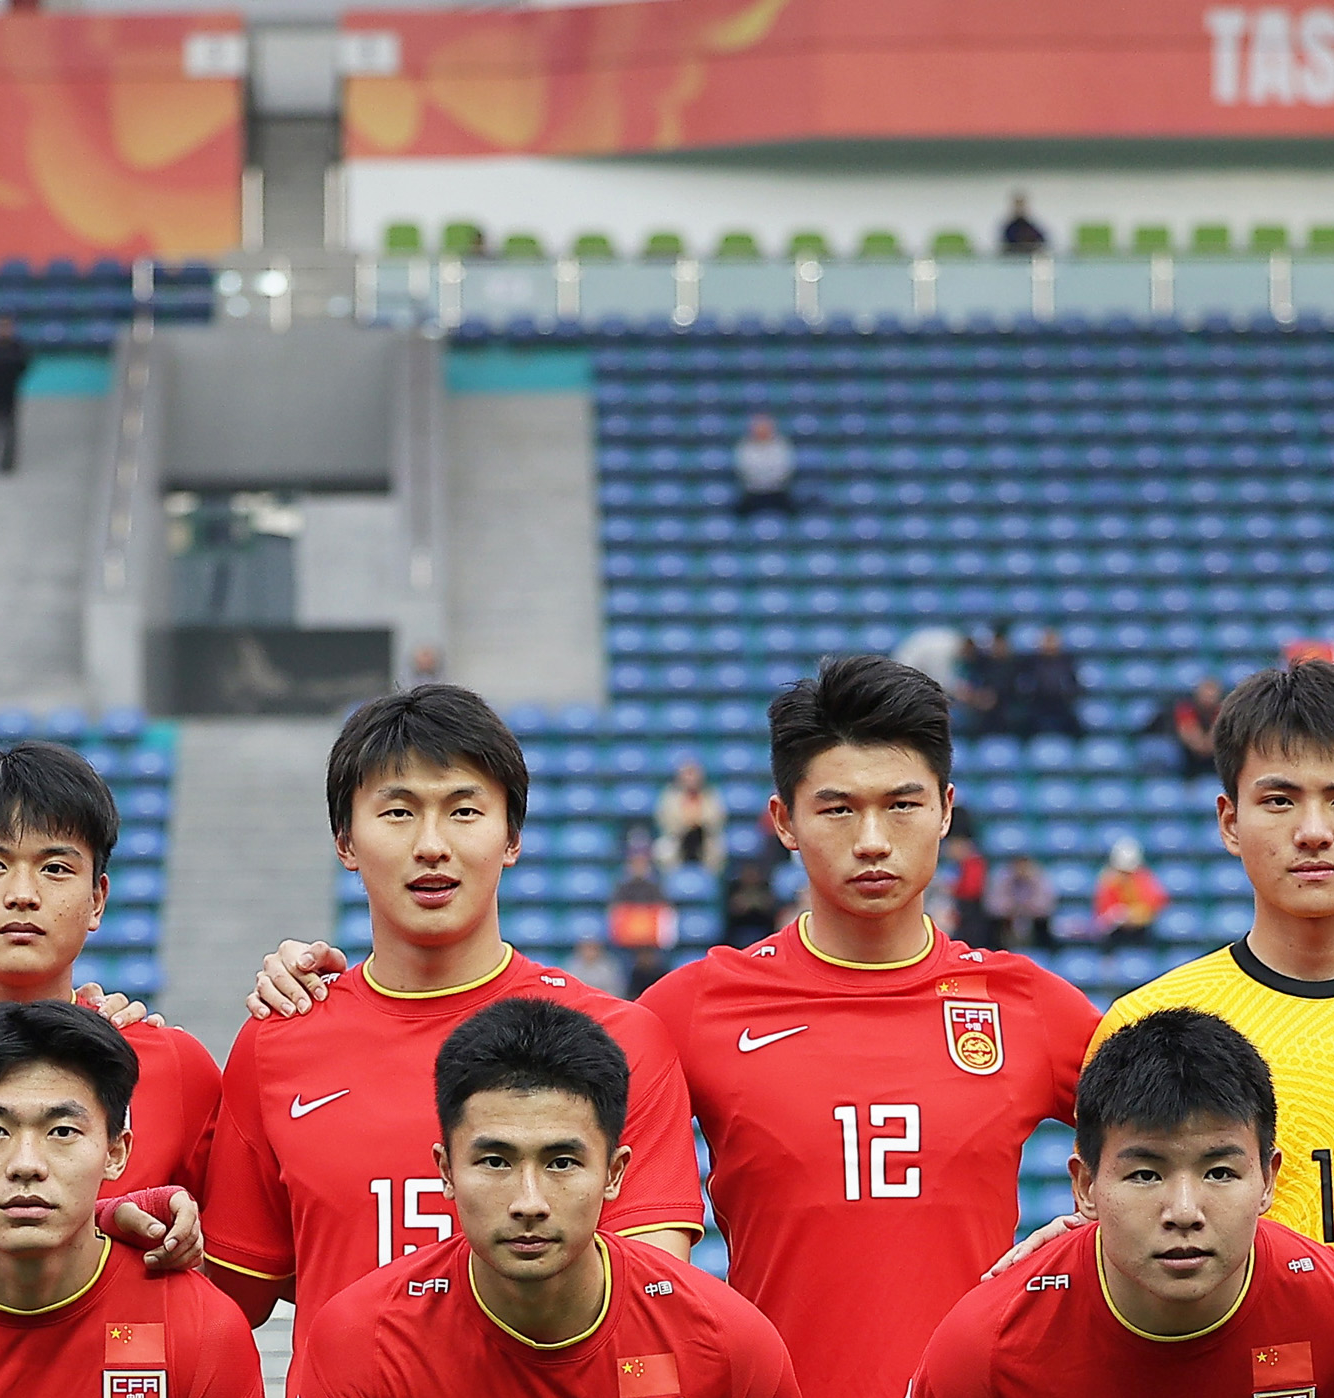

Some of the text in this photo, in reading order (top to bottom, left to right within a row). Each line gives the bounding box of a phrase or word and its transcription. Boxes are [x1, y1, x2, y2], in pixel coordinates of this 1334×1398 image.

[320, 972, 341, 985] FA
[951, 1008, 993, 1023] CFA
[832, 1102, 922, 1201] 12
[1311, 1148, 1334, 1243] 1
[370, 1178, 453, 1268] 15
[1287, 1256, 1315, 1274] 中国
[408, 1278, 449, 1296] CFA
[644, 1280, 673, 1297] 中国
[1026, 1274, 1070, 1292] CFA
[112, 1378, 158, 1393] CFA
